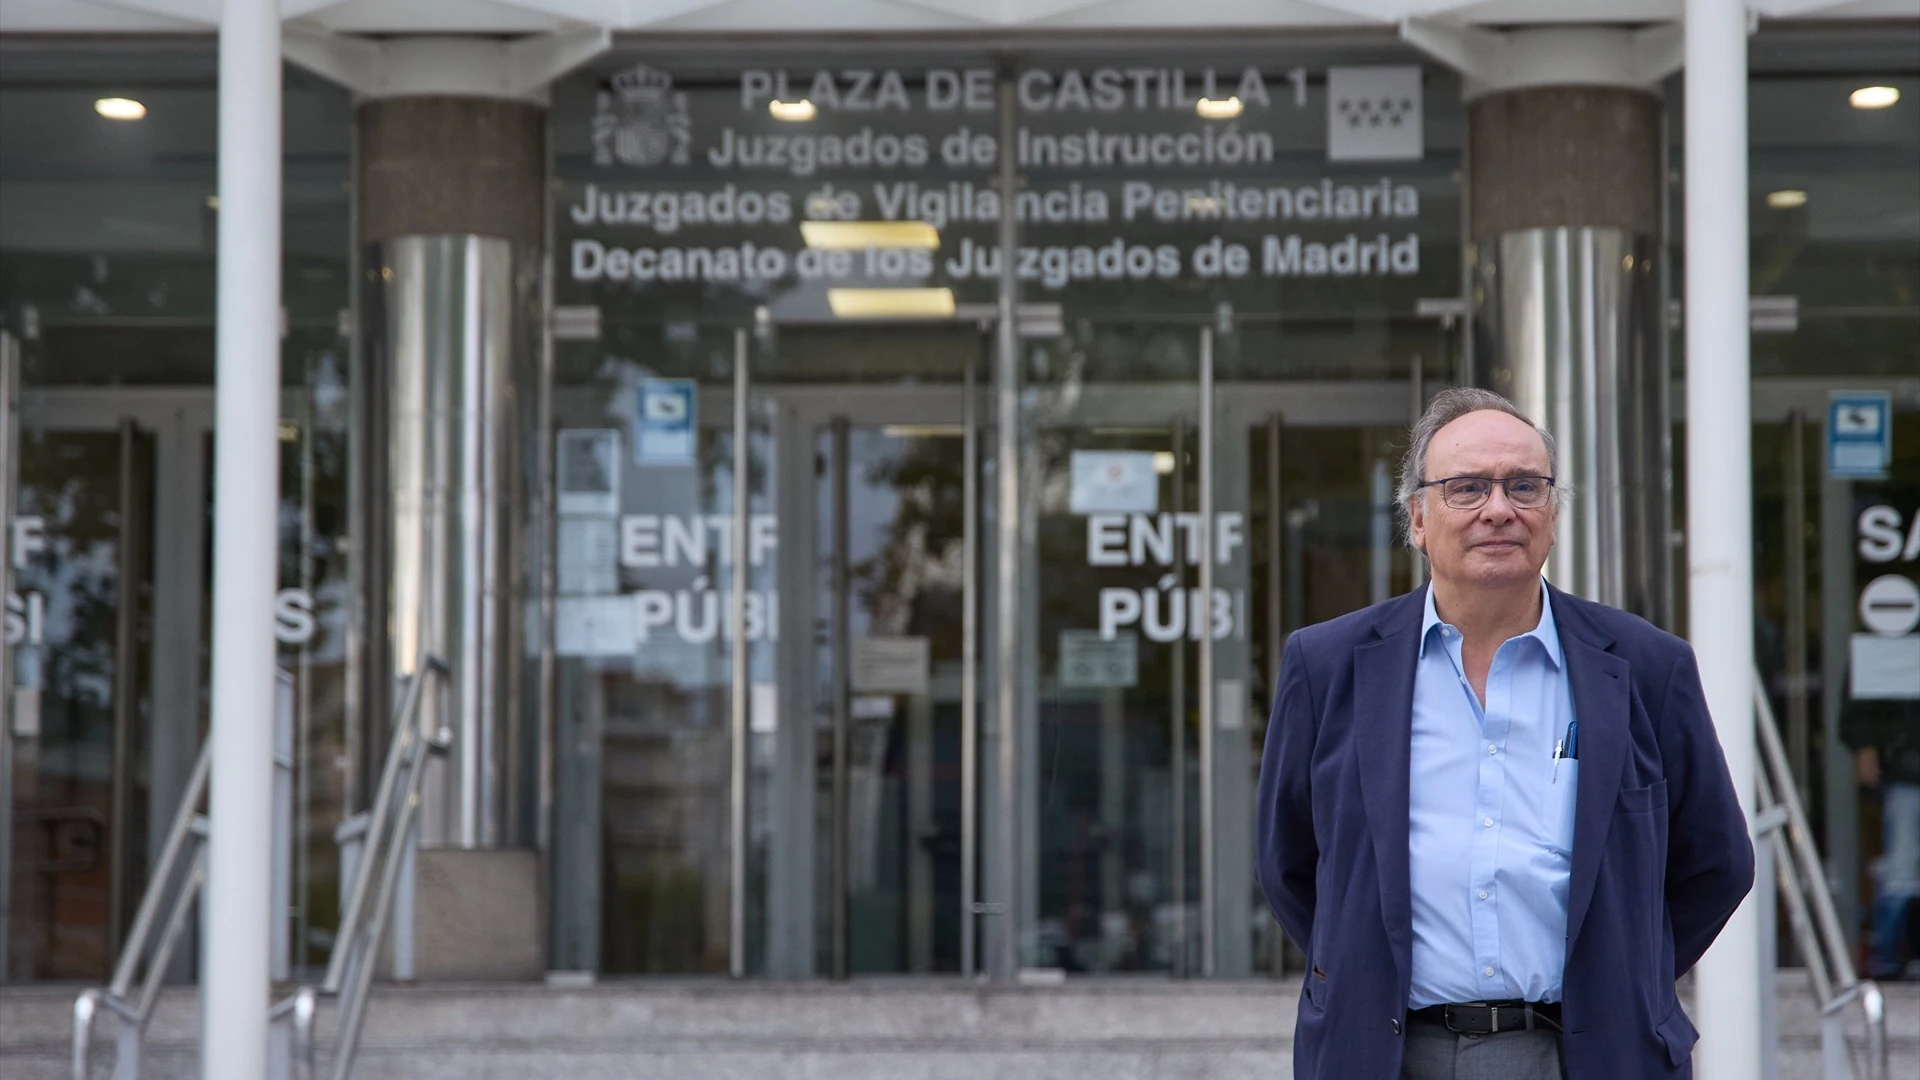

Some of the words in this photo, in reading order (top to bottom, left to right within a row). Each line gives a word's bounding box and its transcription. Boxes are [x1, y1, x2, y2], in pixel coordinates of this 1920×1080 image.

[742, 70, 909, 111] PLAZA
[926, 70, 995, 110] DE
[1018, 67, 1270, 111] CASTILLA
[1284, 67, 1307, 107] 1
[708, 128, 927, 174] Juzgados
[941, 128, 997, 166] de
[1018, 126, 1273, 166] Instrucción
[571, 183, 791, 232] Juzgados
[805, 183, 861, 220] de
[873, 181, 1109, 229] Vigilancia
[1122, 178, 1419, 221] Penitenciaria
[572, 241, 786, 280] Decanato
[795, 241, 852, 279] de
[864, 241, 933, 279] los
[946, 237, 1181, 289] Juzgados
[1193, 236, 1249, 278] de
[1262, 233, 1419, 276] Madrid
